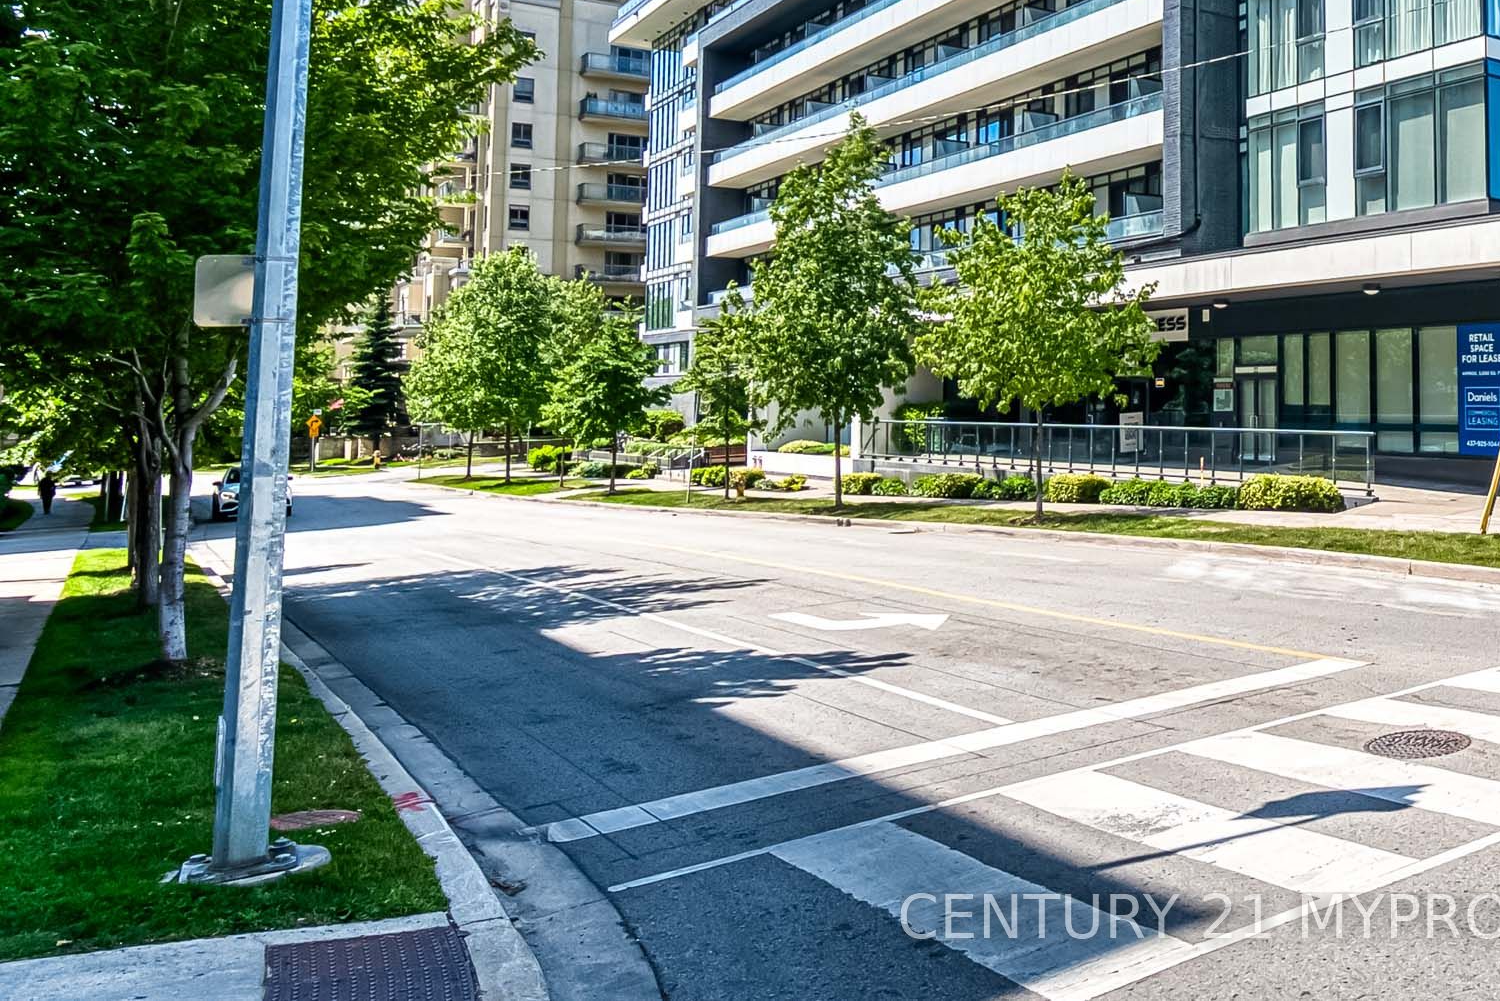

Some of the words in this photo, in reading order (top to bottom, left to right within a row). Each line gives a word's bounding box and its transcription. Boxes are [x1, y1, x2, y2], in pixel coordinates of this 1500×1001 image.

[1469, 333, 1494, 342] RETAIL
[1470, 343, 1494, 352] SPACE
[1462, 355, 1477, 363] FOR
[1467, 392, 1497, 401] Daniels
[1468, 417, 1499, 425] LEASING
